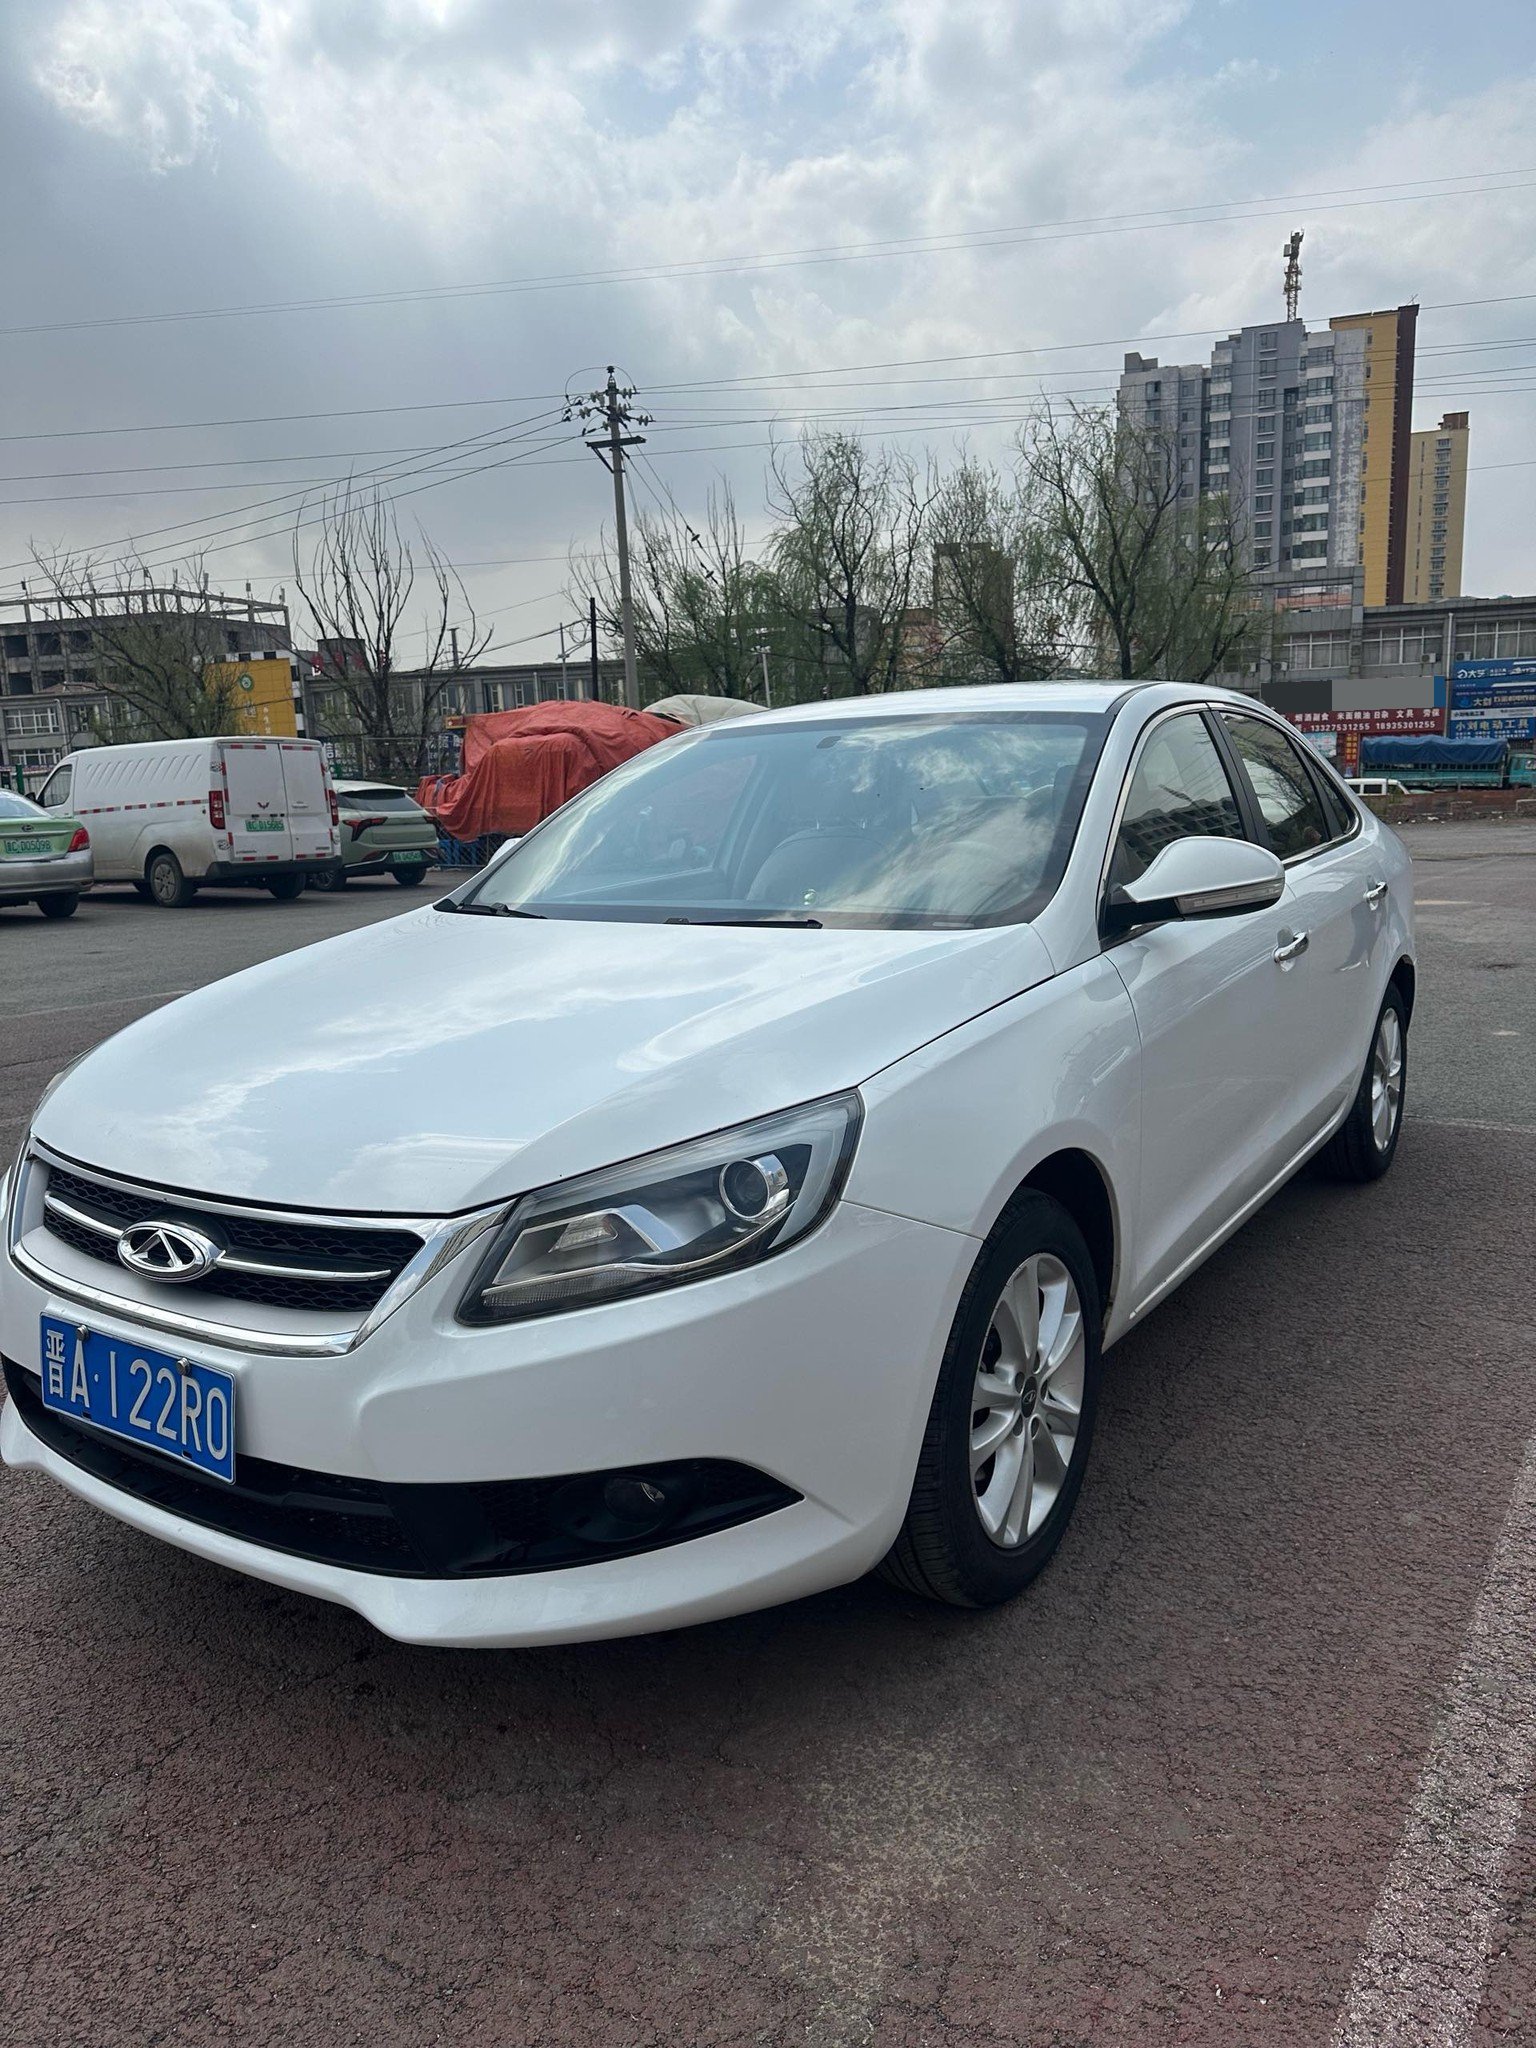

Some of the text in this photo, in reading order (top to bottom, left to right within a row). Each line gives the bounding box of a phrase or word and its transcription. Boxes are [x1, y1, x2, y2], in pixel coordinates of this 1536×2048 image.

[1396, 708, 1414, 719] 文具
[1310, 723, 1371, 732] 13327531255
[1455, 719, 1529, 731] 小刘电动工具
